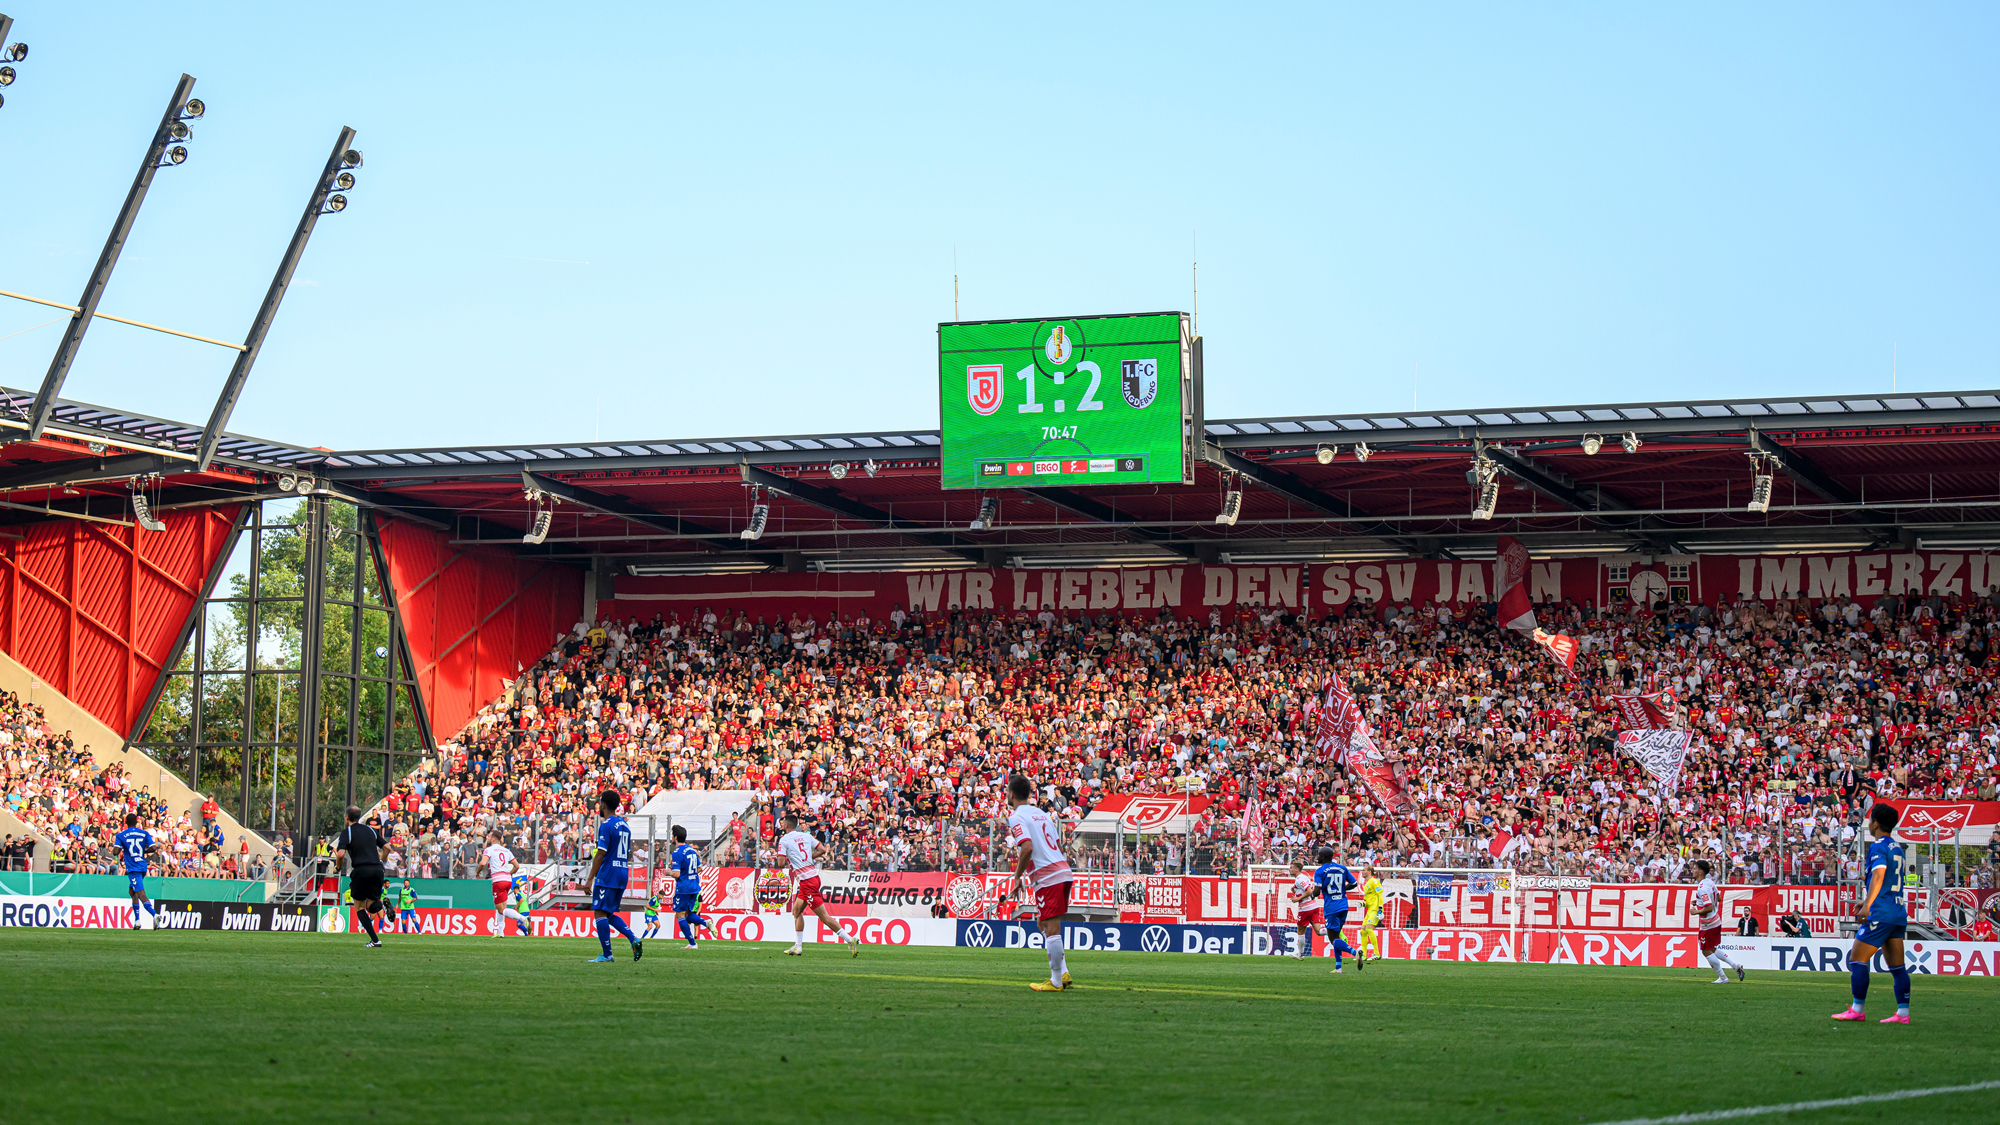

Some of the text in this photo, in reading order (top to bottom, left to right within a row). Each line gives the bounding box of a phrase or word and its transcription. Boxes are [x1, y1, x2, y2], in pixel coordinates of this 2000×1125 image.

[1123, 380, 1156, 406] MAGDEBURG
[1041, 425, 1078, 440] 70:47
[984, 463, 1002, 472] bwin
[1036, 463, 1059, 472] ERGO
[905, 571, 994, 612] WIR
[1013, 567, 1184, 611] LIEBEN
[1202, 566, 1299, 608] DEN
[1322, 562, 1417, 605] SSV
[1437, 562, 1562, 603] JAN
[1738, 554, 2000, 601] IMMERZU
[126, 838, 143, 857] 25
[1042, 822, 1057, 850] 6
[499, 852, 506, 868] 9
[798, 842, 808, 862] 5
[686, 854, 698, 874] 24
[1891, 854, 1905, 892] 3
[848, 873, 890, 884] Fanclub
[1148, 877, 1162, 886] SSV
[1163, 878, 1182, 886] JAHN
[1326, 873, 1343, 894] 29
[1514, 877, 1536, 889] RED
[797, 886, 943, 907] GENSBURG 81
[1147, 887, 1182, 907] 1889
[1430, 886, 1754, 929] REGENSBUG
[1775, 889, 1835, 914] JAHN
[0, 902, 134, 929] RGO BANK
[159, 903, 202, 929] bwin
[221, 905, 261, 931] bwin
[271, 907, 311, 932] bwin
[516, 915, 621, 938] TRAU
[1775, 917, 1835, 933] SION
[817, 918, 911, 946] ERGO
[1006, 926, 1121, 951] De ID.3
[1183, 929, 1234, 954] Der
[1937, 949, 2000, 977] BA
